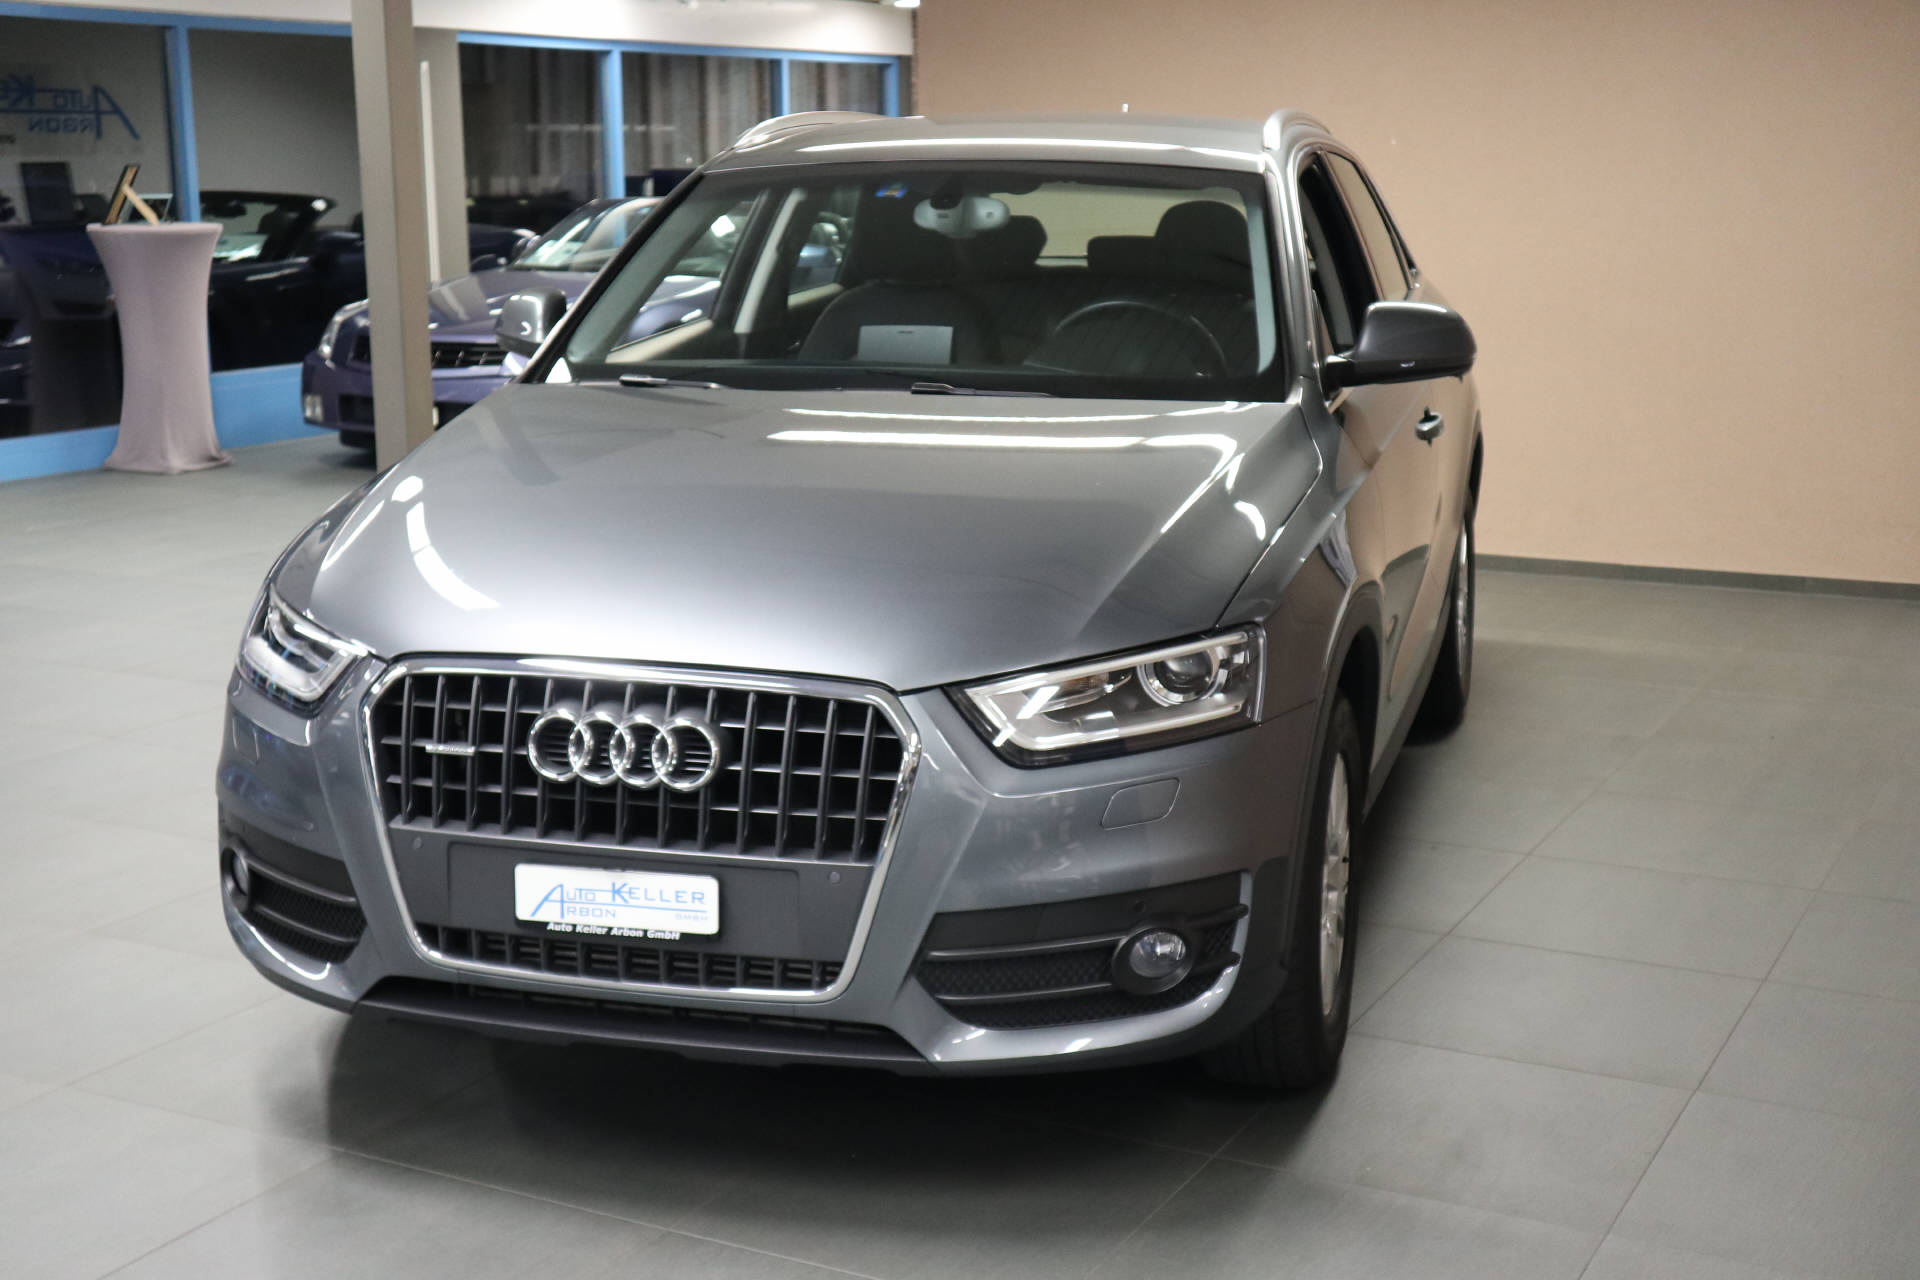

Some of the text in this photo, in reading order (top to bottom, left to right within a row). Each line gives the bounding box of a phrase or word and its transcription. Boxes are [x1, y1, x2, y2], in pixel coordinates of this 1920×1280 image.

[611, 881, 705, 904] KELLER
[546, 921, 681, 941] Auto Keller Arbon GmbH
